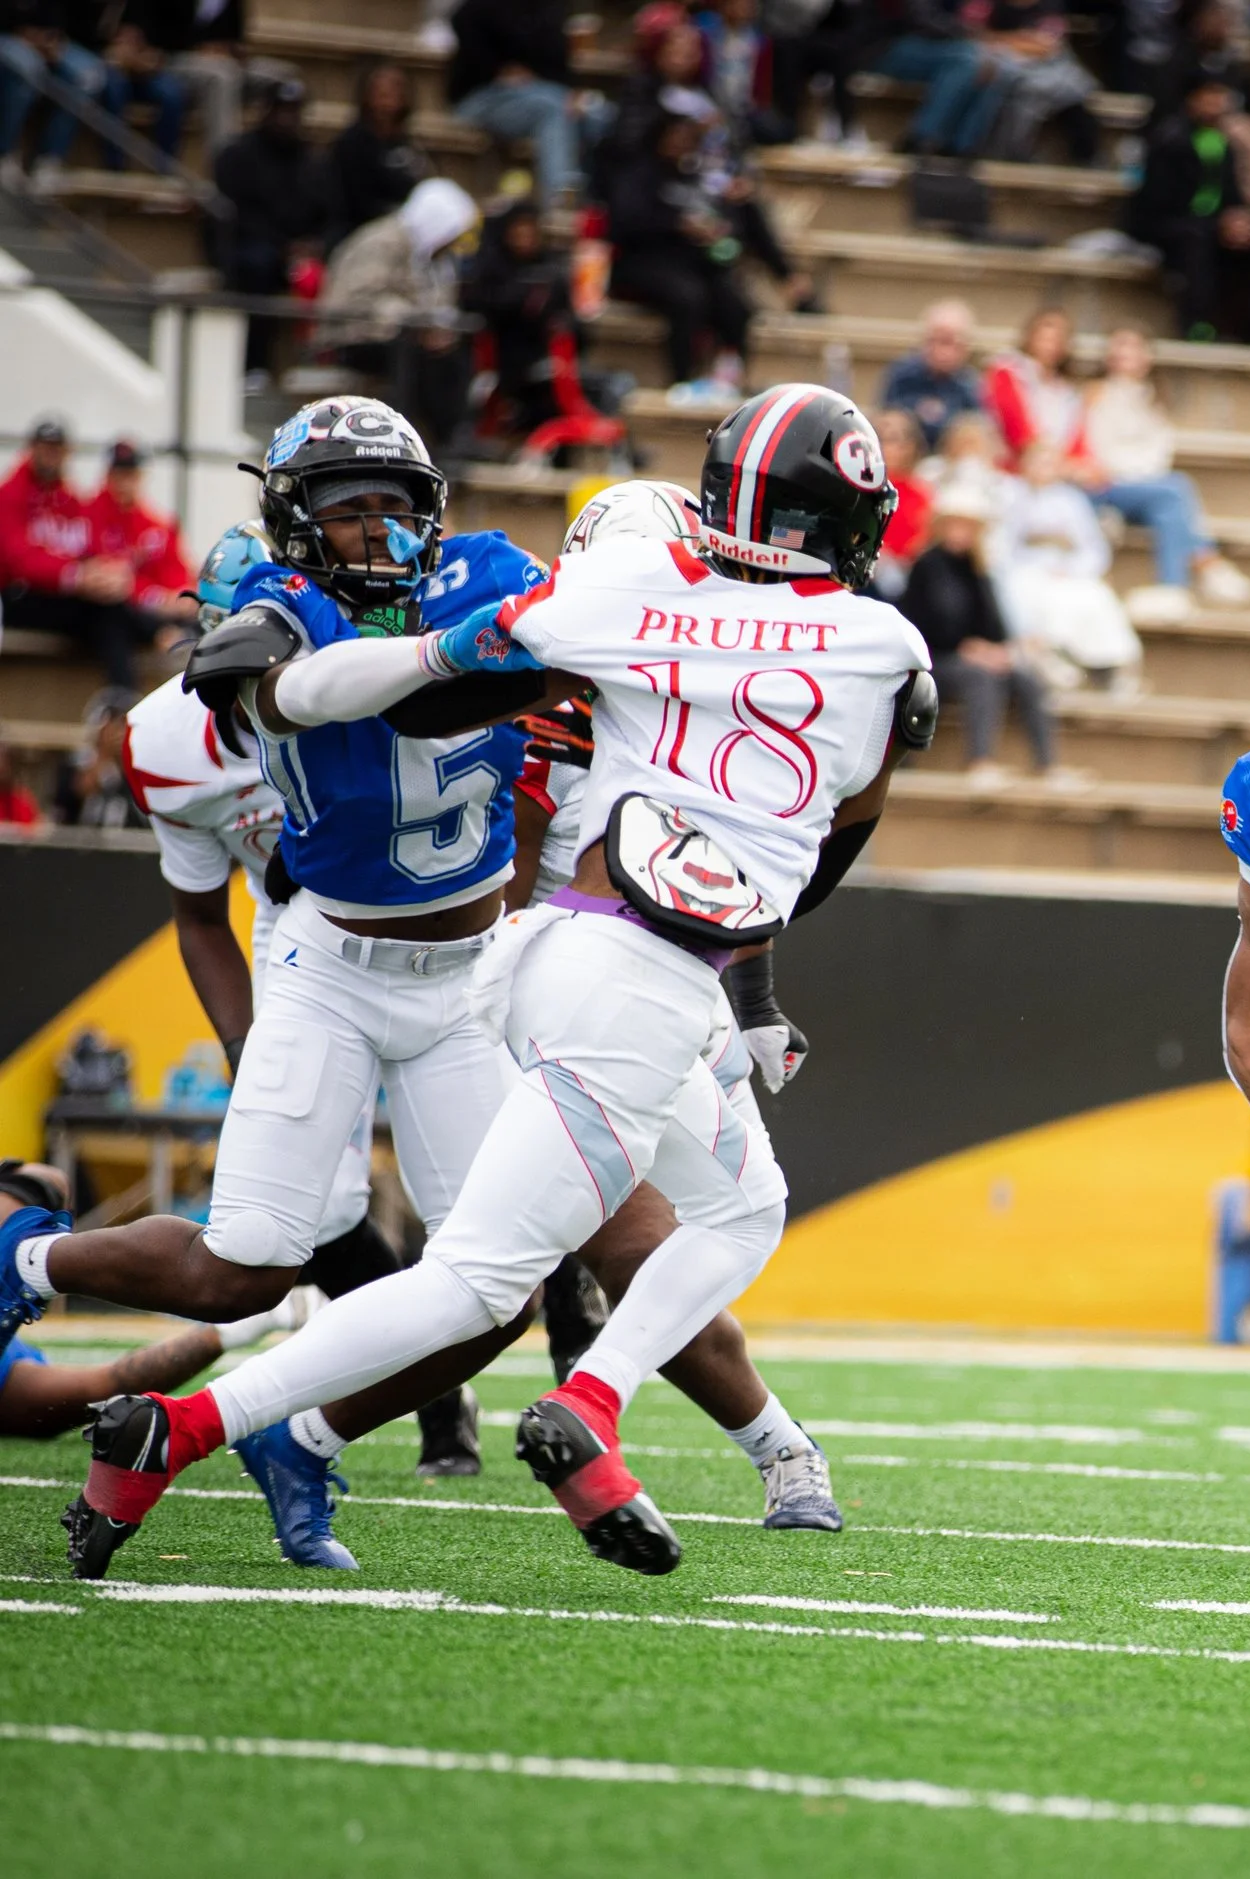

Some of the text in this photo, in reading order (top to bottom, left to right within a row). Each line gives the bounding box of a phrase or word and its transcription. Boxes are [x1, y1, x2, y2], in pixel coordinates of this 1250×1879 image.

[355, 445, 401, 457] Riddell
[708, 533, 789, 566] Riddell
[631, 606, 838, 652] PRUITT
[627, 660, 824, 819] 18
[389, 726, 501, 885] 5
